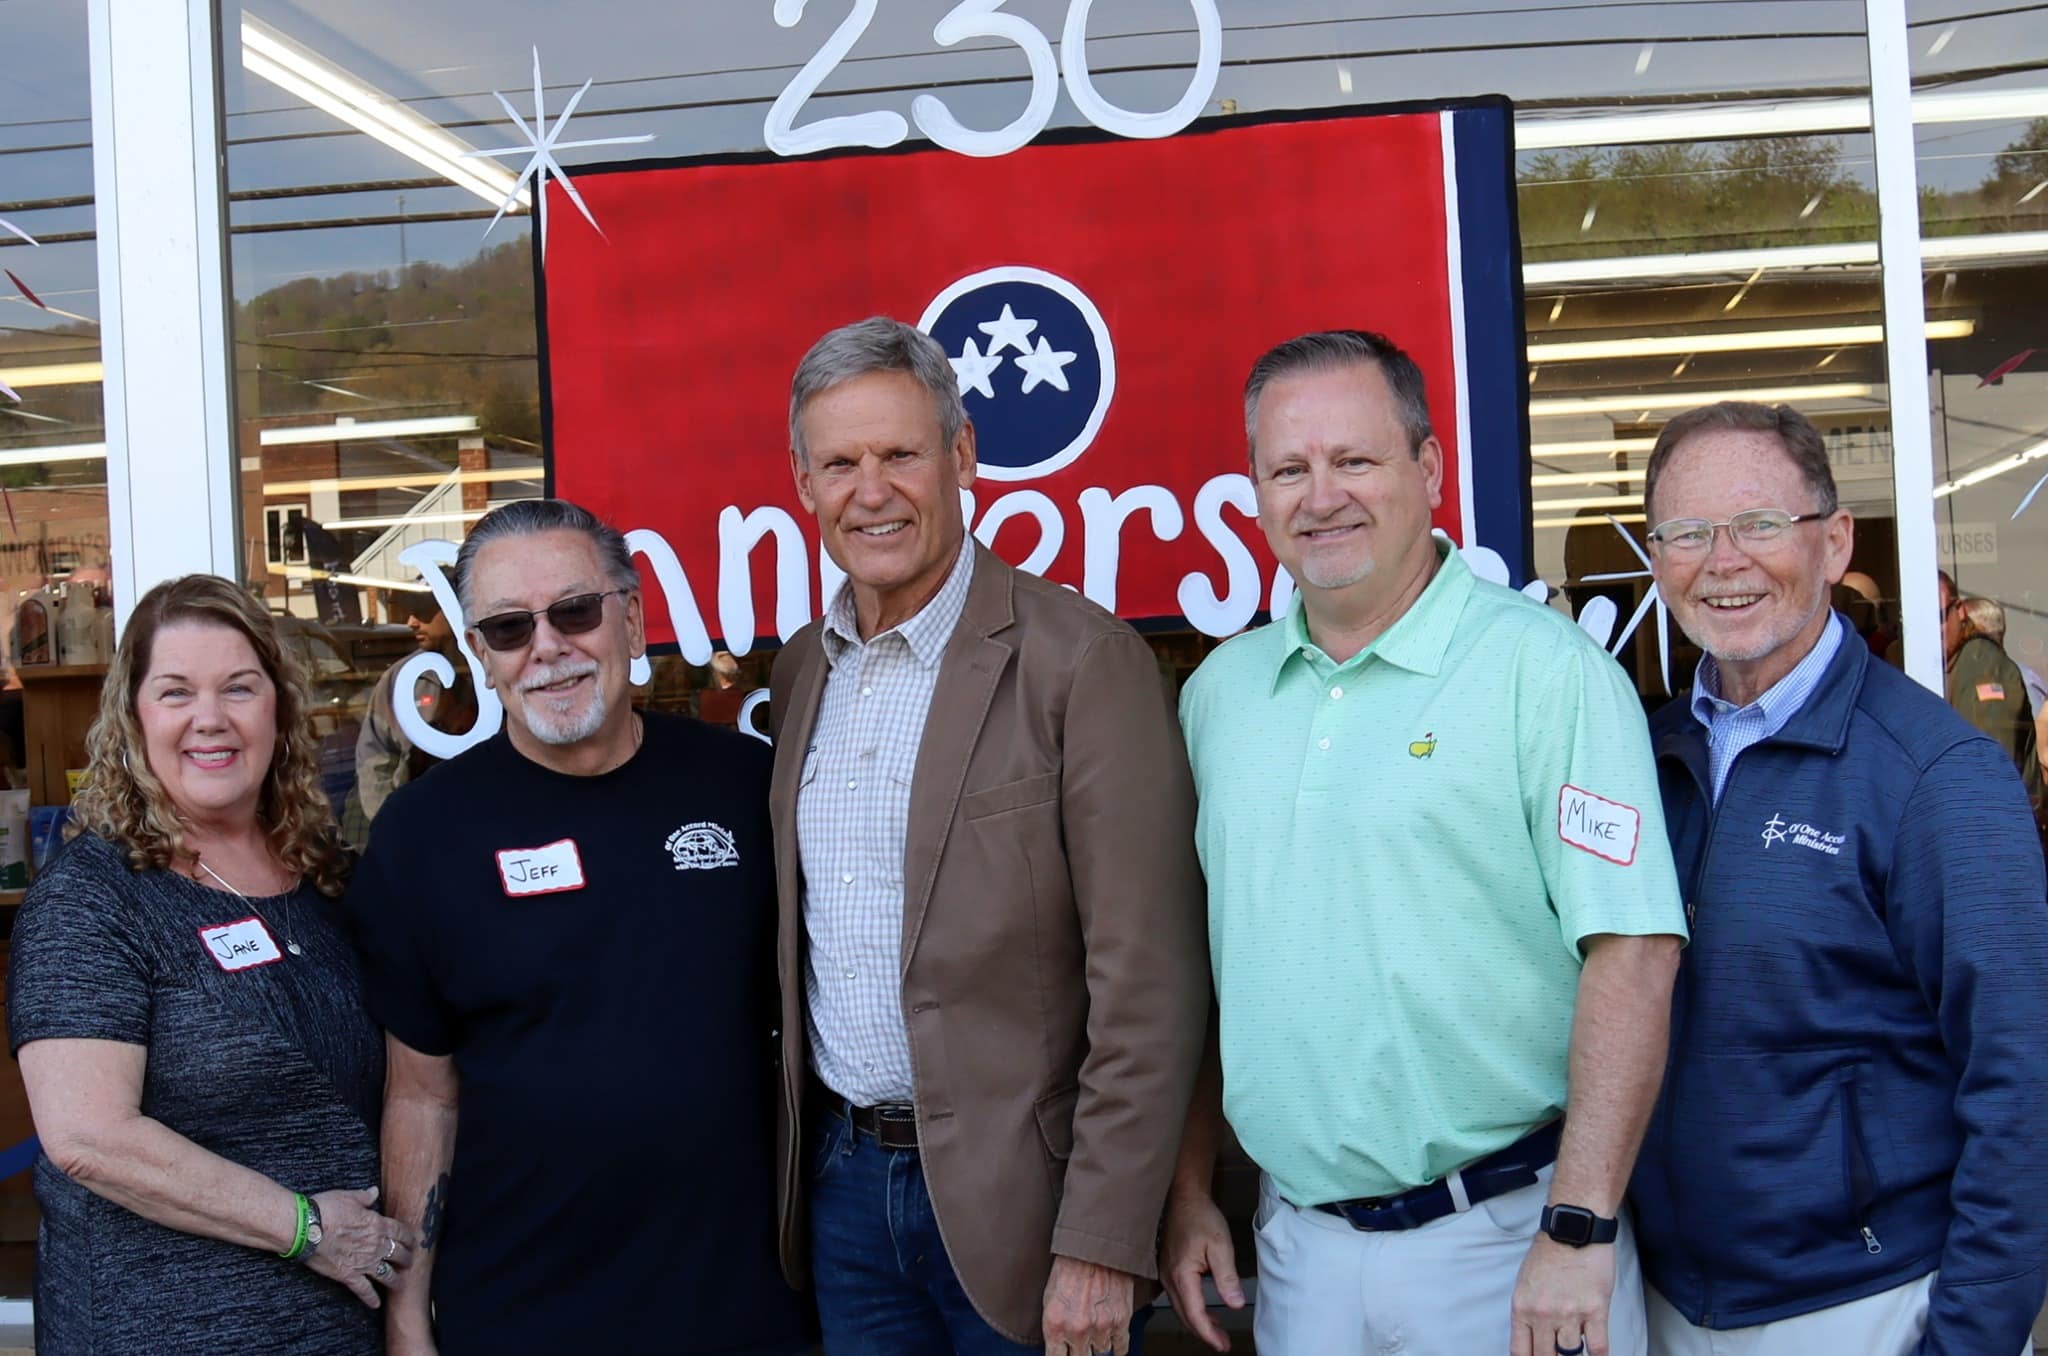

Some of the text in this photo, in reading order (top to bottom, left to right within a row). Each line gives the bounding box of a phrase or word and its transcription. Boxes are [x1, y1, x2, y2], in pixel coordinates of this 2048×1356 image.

[1937, 531, 1994, 555] URSES
[1566, 797, 1621, 841] MIKE
[1800, 824, 1821, 837] One
[509, 858, 559, 883] JEFF
[211, 932, 260, 960] JANE
